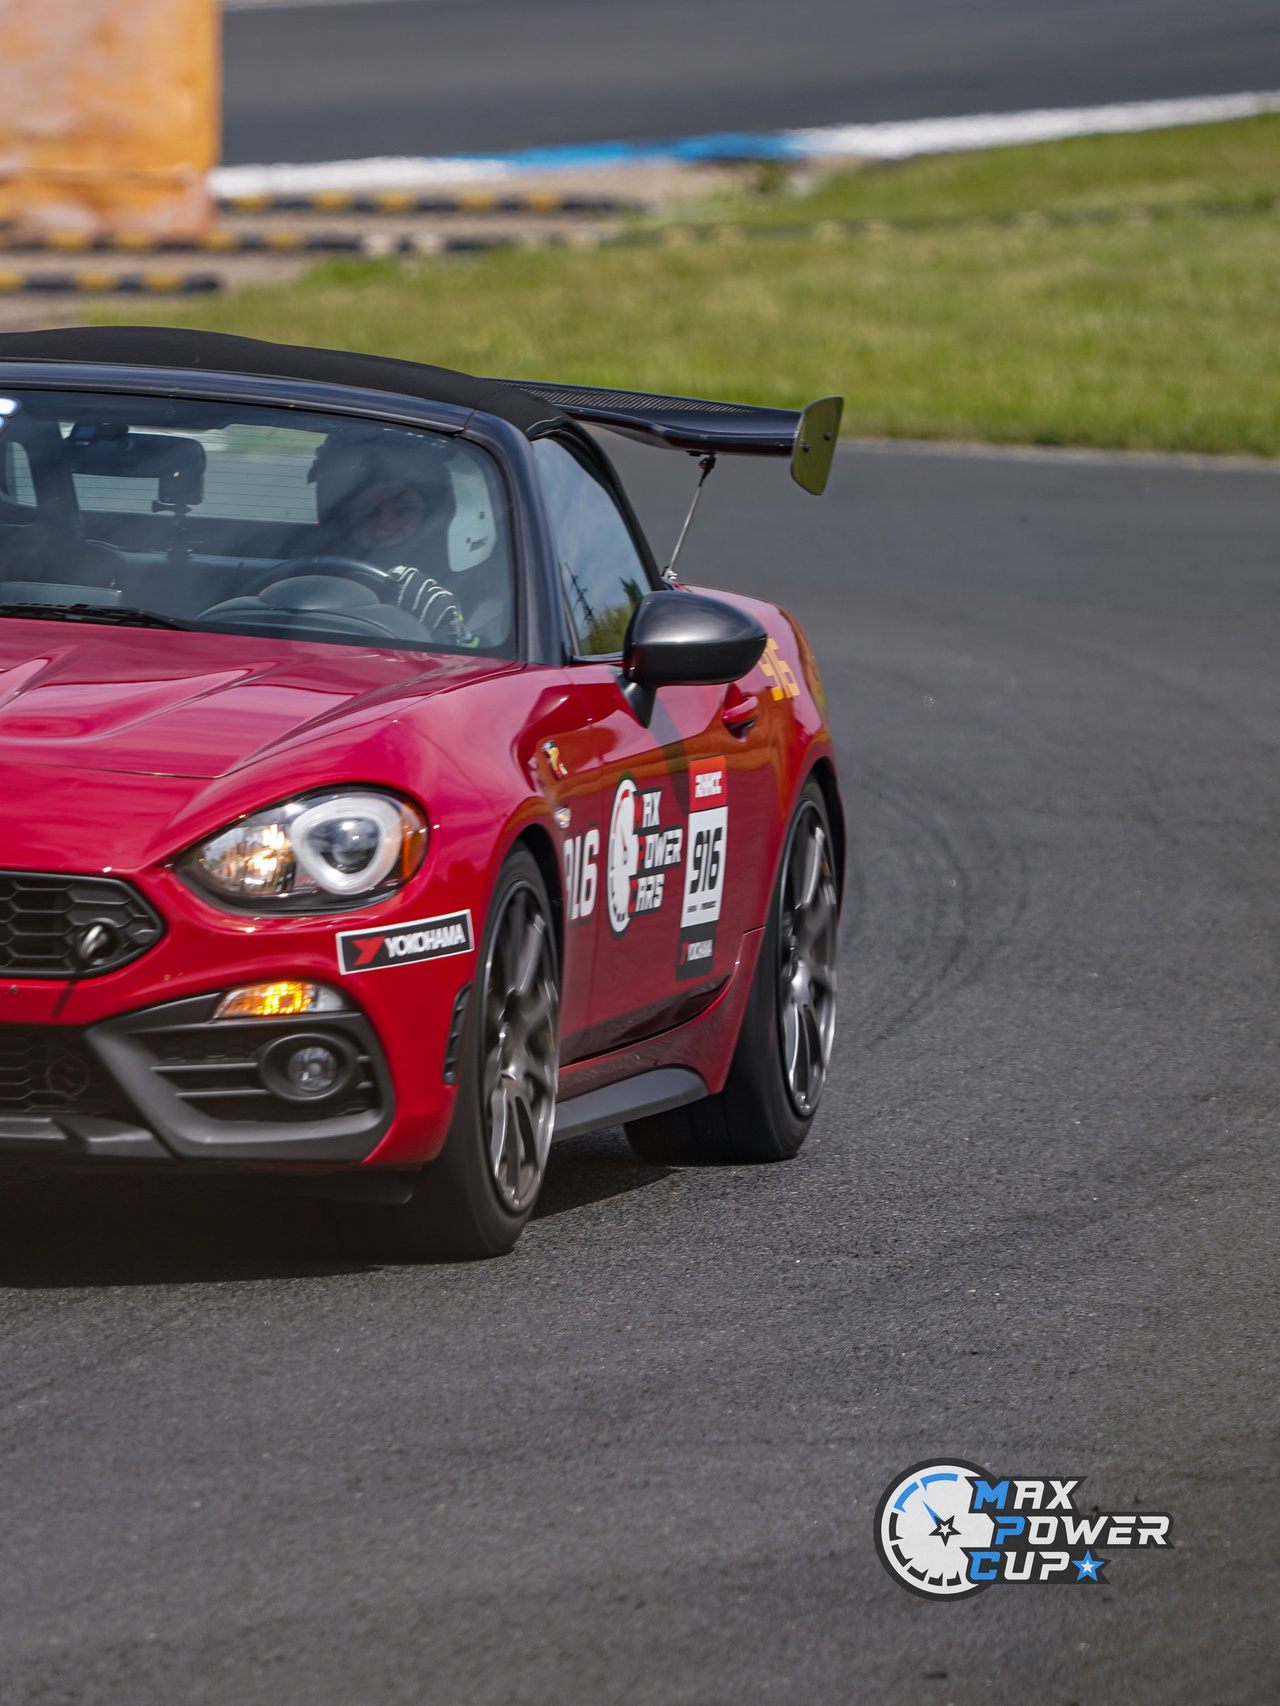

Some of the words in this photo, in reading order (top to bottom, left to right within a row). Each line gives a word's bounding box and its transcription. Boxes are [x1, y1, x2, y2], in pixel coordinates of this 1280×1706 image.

[637, 828, 683, 873] POWER
[689, 827, 723, 894] 916
[384, 923, 467, 958] YOKOHAMA
